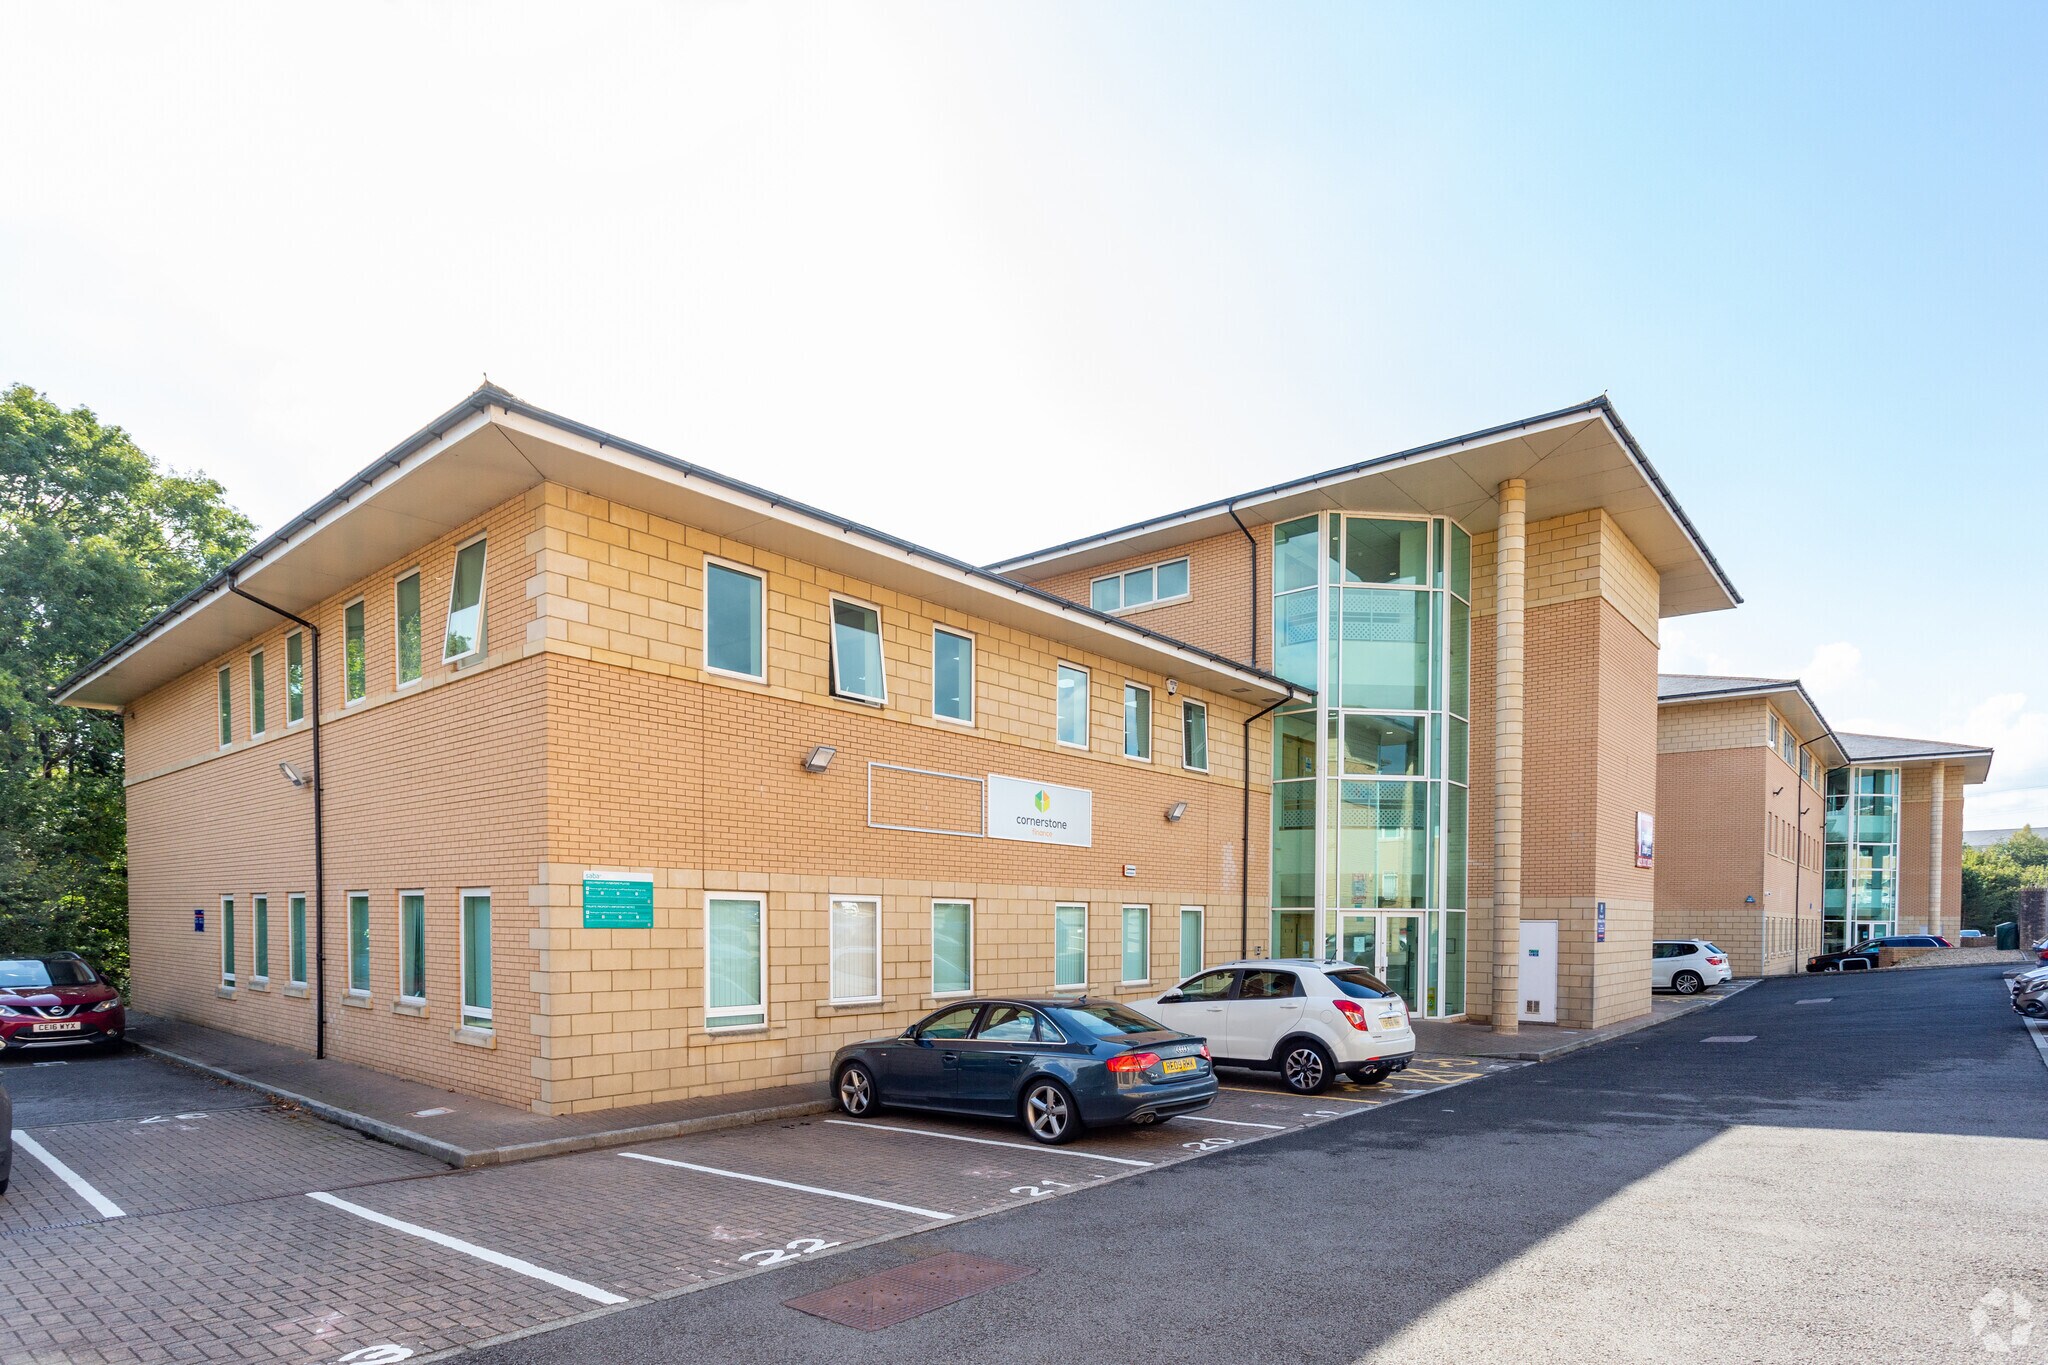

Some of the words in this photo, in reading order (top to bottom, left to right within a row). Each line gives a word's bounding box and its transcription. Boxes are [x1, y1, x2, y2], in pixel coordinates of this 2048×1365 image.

[1016, 816, 1067, 830] cornerstone
[59, 1022, 76, 1030] WYX
[1182, 1137, 1235, 1152] 20
[1009, 1179, 1073, 1198] 21
[737, 1238, 842, 1267] 22
